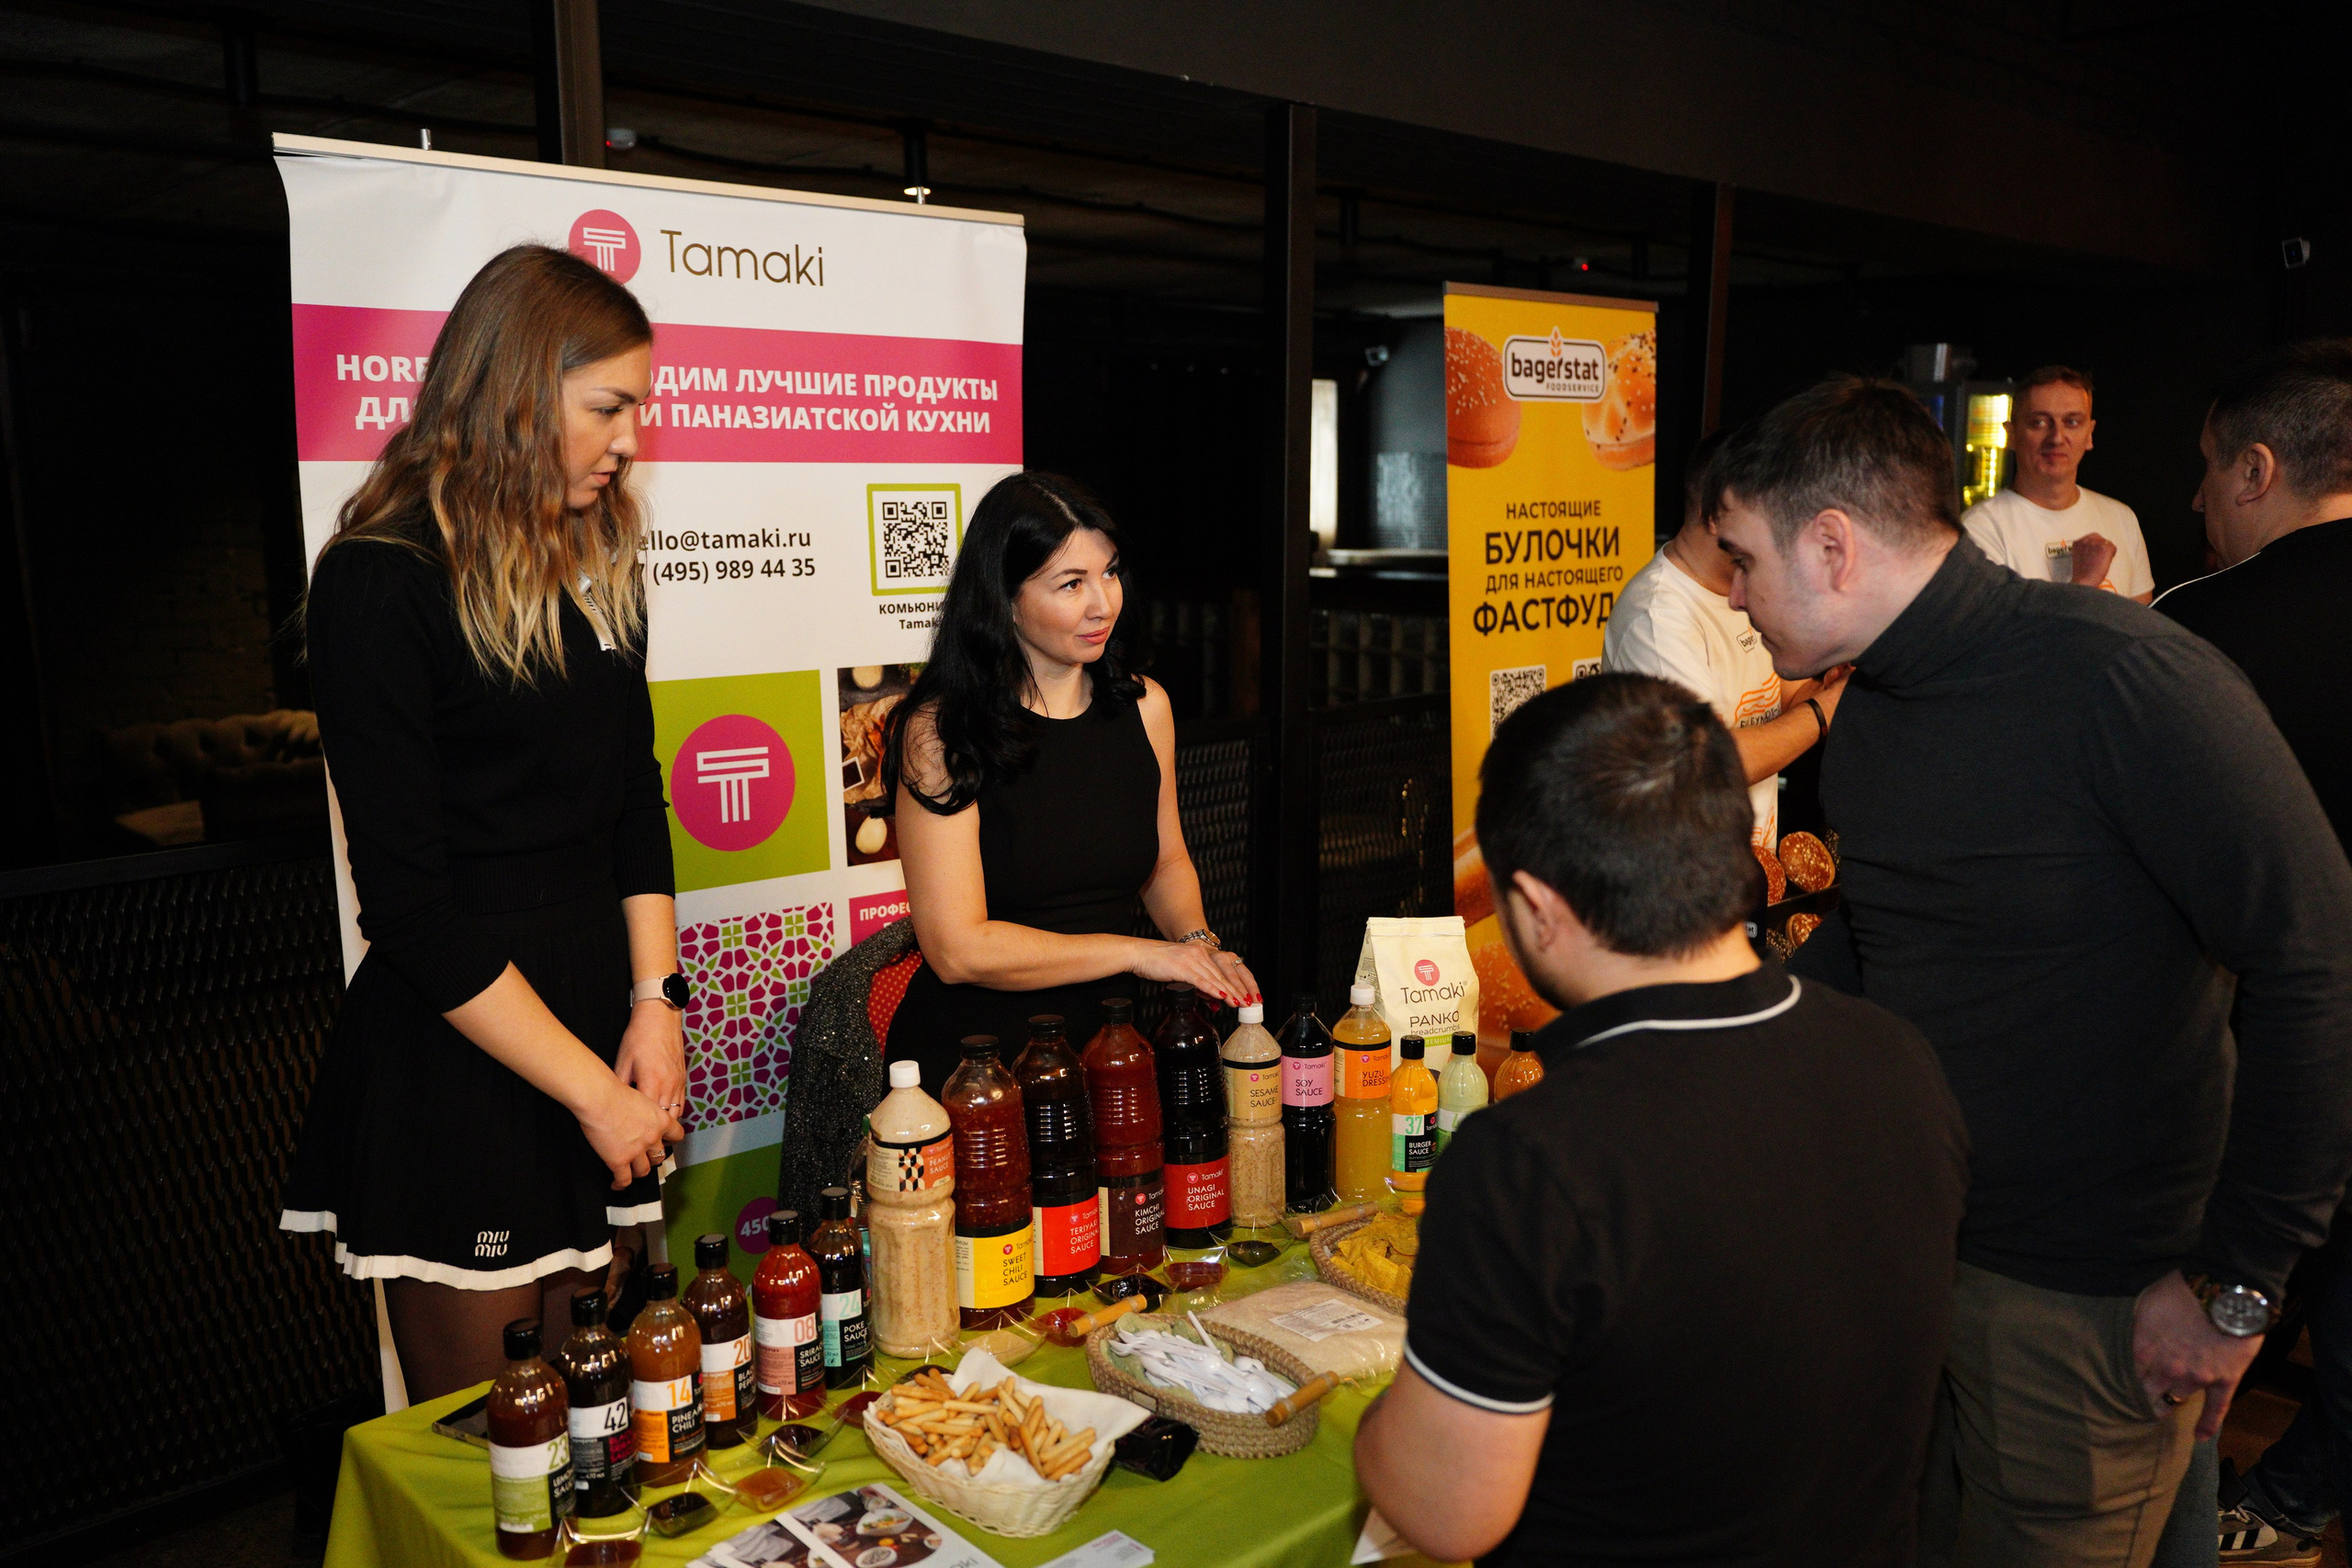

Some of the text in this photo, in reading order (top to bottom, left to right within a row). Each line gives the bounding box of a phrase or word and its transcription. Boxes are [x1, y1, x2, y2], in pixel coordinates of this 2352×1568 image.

[661, 229, 824, 287] Tamaki
[1511, 352, 1599, 383] bagerstat
[336, 355, 999, 404] HORE ДИМ ЛУЧШИЕ ПРОДУКТЫ
[1545, 382, 1599, 393] FOODSERVICE
[355, 396, 990, 434] ДЛ И ПАНАЗИАТСКОЙ КУХНИ
[1506, 501, 1601, 520] НАСТОЯЩИЕ
[639, 528, 811, 551] ello@tamaki.ru
[1485, 526, 1620, 565] БУЛОЧКИ
[652, 560, 709, 586] (495)
[716, 559, 754, 580] 989
[760, 558, 786, 577] 44
[791, 558, 816, 576] 35
[1485, 566, 1623, 595] ДЛЯ НАСТОЯЩЕГО
[879, 602, 944, 615] КОМЬЮНИ
[899, 617, 936, 630] Tamak
[1409, 1010, 1460, 1028] PANKO
[1410, 1024, 1461, 1036] breadcrumbs
[1425, 1036, 1453, 1045] REMIUM
[1362, 1069, 1385, 1079] YUZU
[1295, 1078, 1314, 1088] SOY
[1250, 1085, 1279, 1098] SESAME
[1295, 1088, 1323, 1097] SAUCE
[1250, 1097, 1276, 1109] SAUCE
[1405, 1115, 1423, 1134] 37
[1408, 1140, 1431, 1148] BURGER
[1408, 1147, 1430, 1156] SAUCE
[930, 1161, 949, 1175] SAUCE
[1187, 1184, 1216, 1195] UNAGI
[1187, 1189, 1225, 1202] ORIGINAL
[1135, 1202, 1160, 1218] KIMCHI
[1188, 1201, 1216, 1211] SAUCE
[1135, 1221, 1159, 1235] SAUCE
[1070, 1239, 1094, 1255] SAUCE
[1002, 1251, 1027, 1268] SWEET
[1002, 1263, 1023, 1277] CHILI
[1002, 1270, 1028, 1287] SAUCE
[838, 1292, 861, 1319] 24
[794, 1315, 816, 1343] 08
[843, 1320, 865, 1334] POKE
[843, 1327, 868, 1343] SAUCE
[733, 1335, 752, 1366] 20
[799, 1342, 824, 1359] SRIRAC
[799, 1353, 821, 1368] SAUCE
[667, 1378, 692, 1408] 14
[604, 1401, 628, 1431] 42
[672, 1419, 696, 1434] CHILI
[548, 1434, 569, 1470] 23
